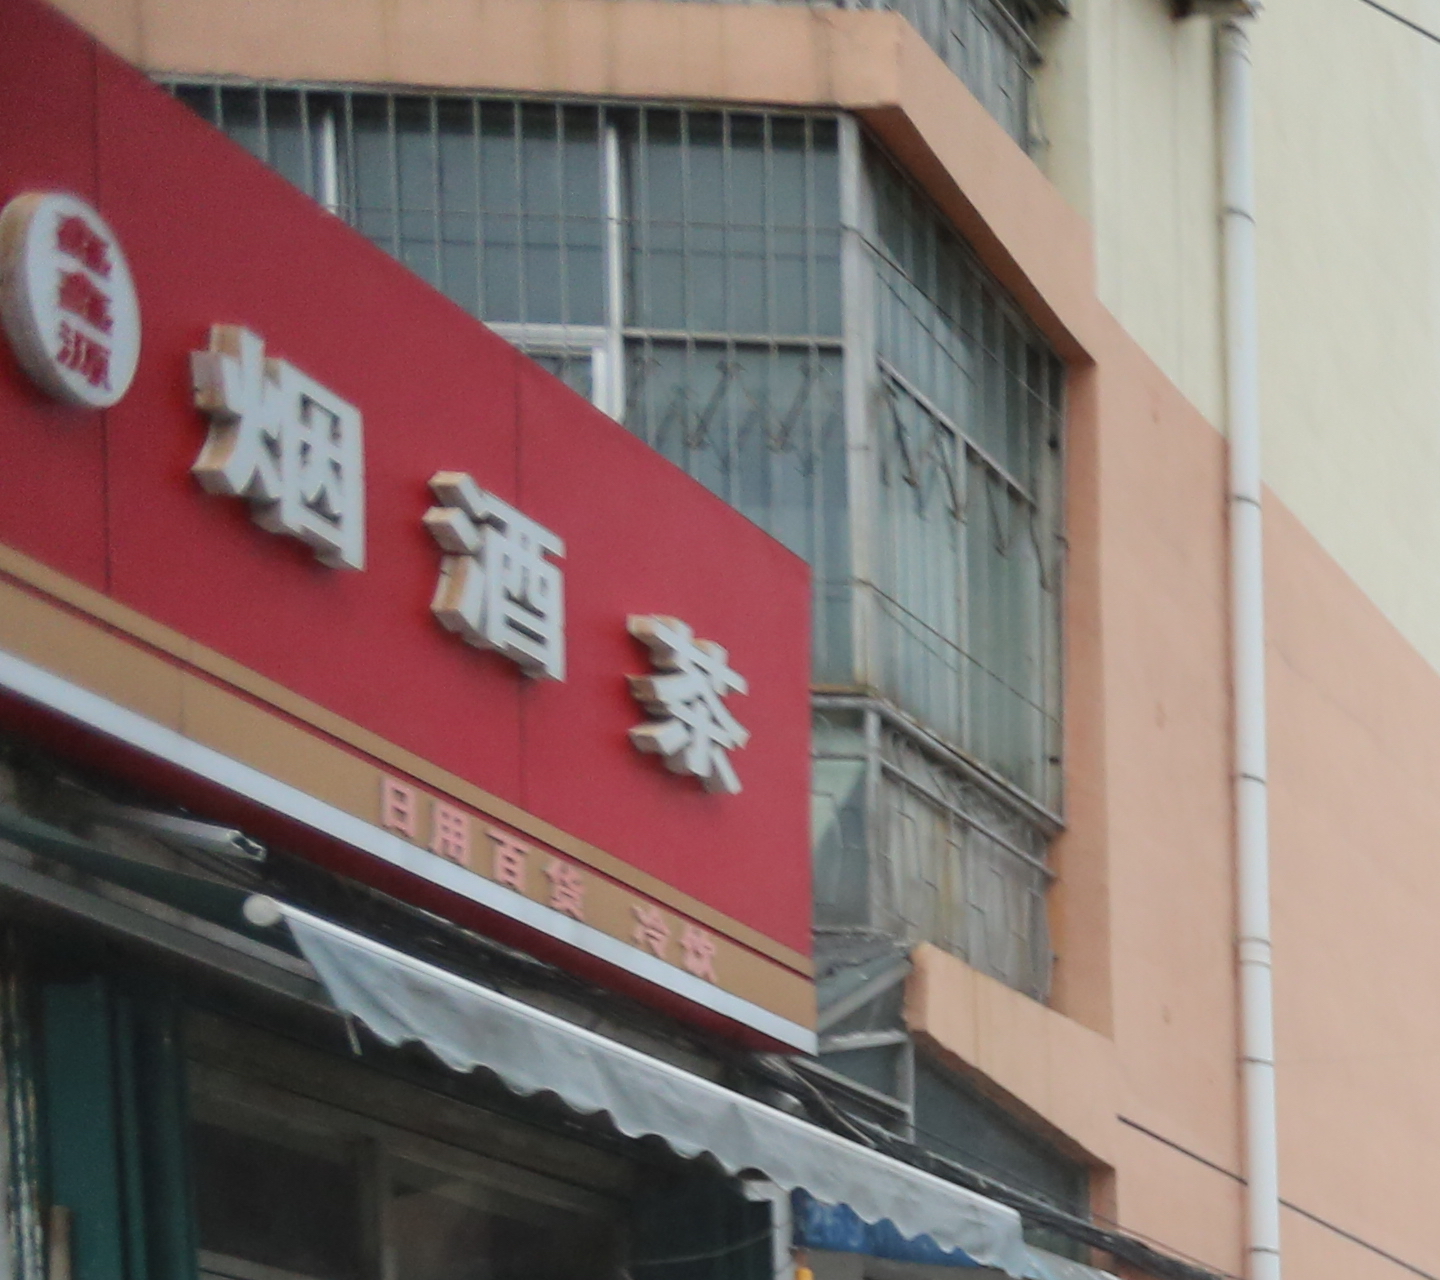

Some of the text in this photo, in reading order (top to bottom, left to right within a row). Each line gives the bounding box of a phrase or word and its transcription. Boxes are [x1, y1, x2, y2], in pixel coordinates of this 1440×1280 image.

[191, 322, 748, 795] 烟酒茶
[382, 777, 585, 922] 日用百货
